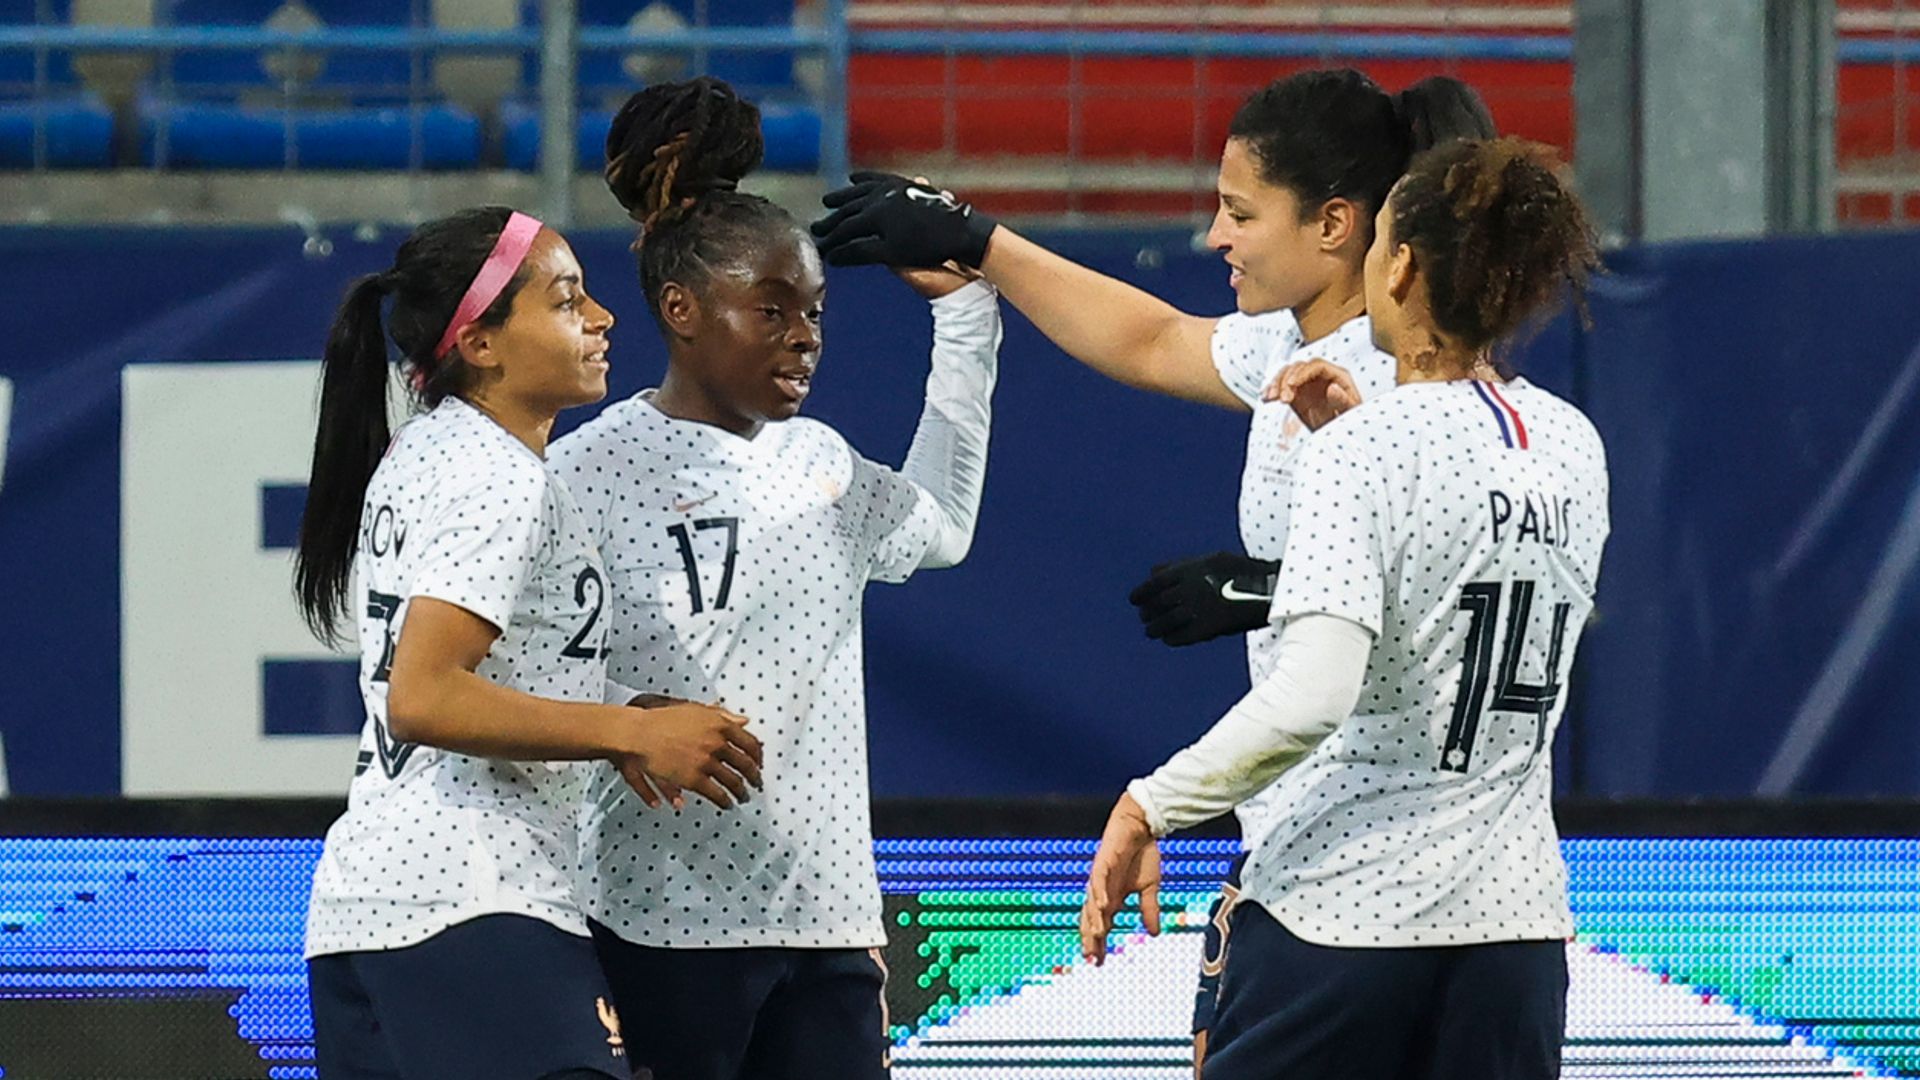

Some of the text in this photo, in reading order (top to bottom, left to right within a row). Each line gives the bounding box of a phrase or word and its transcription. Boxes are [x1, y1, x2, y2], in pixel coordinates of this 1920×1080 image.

[665, 517, 739, 614] 17
[1488, 489, 1571, 548] PALIS
[561, 565, 609, 665] 2
[1440, 580, 1571, 774] 14
